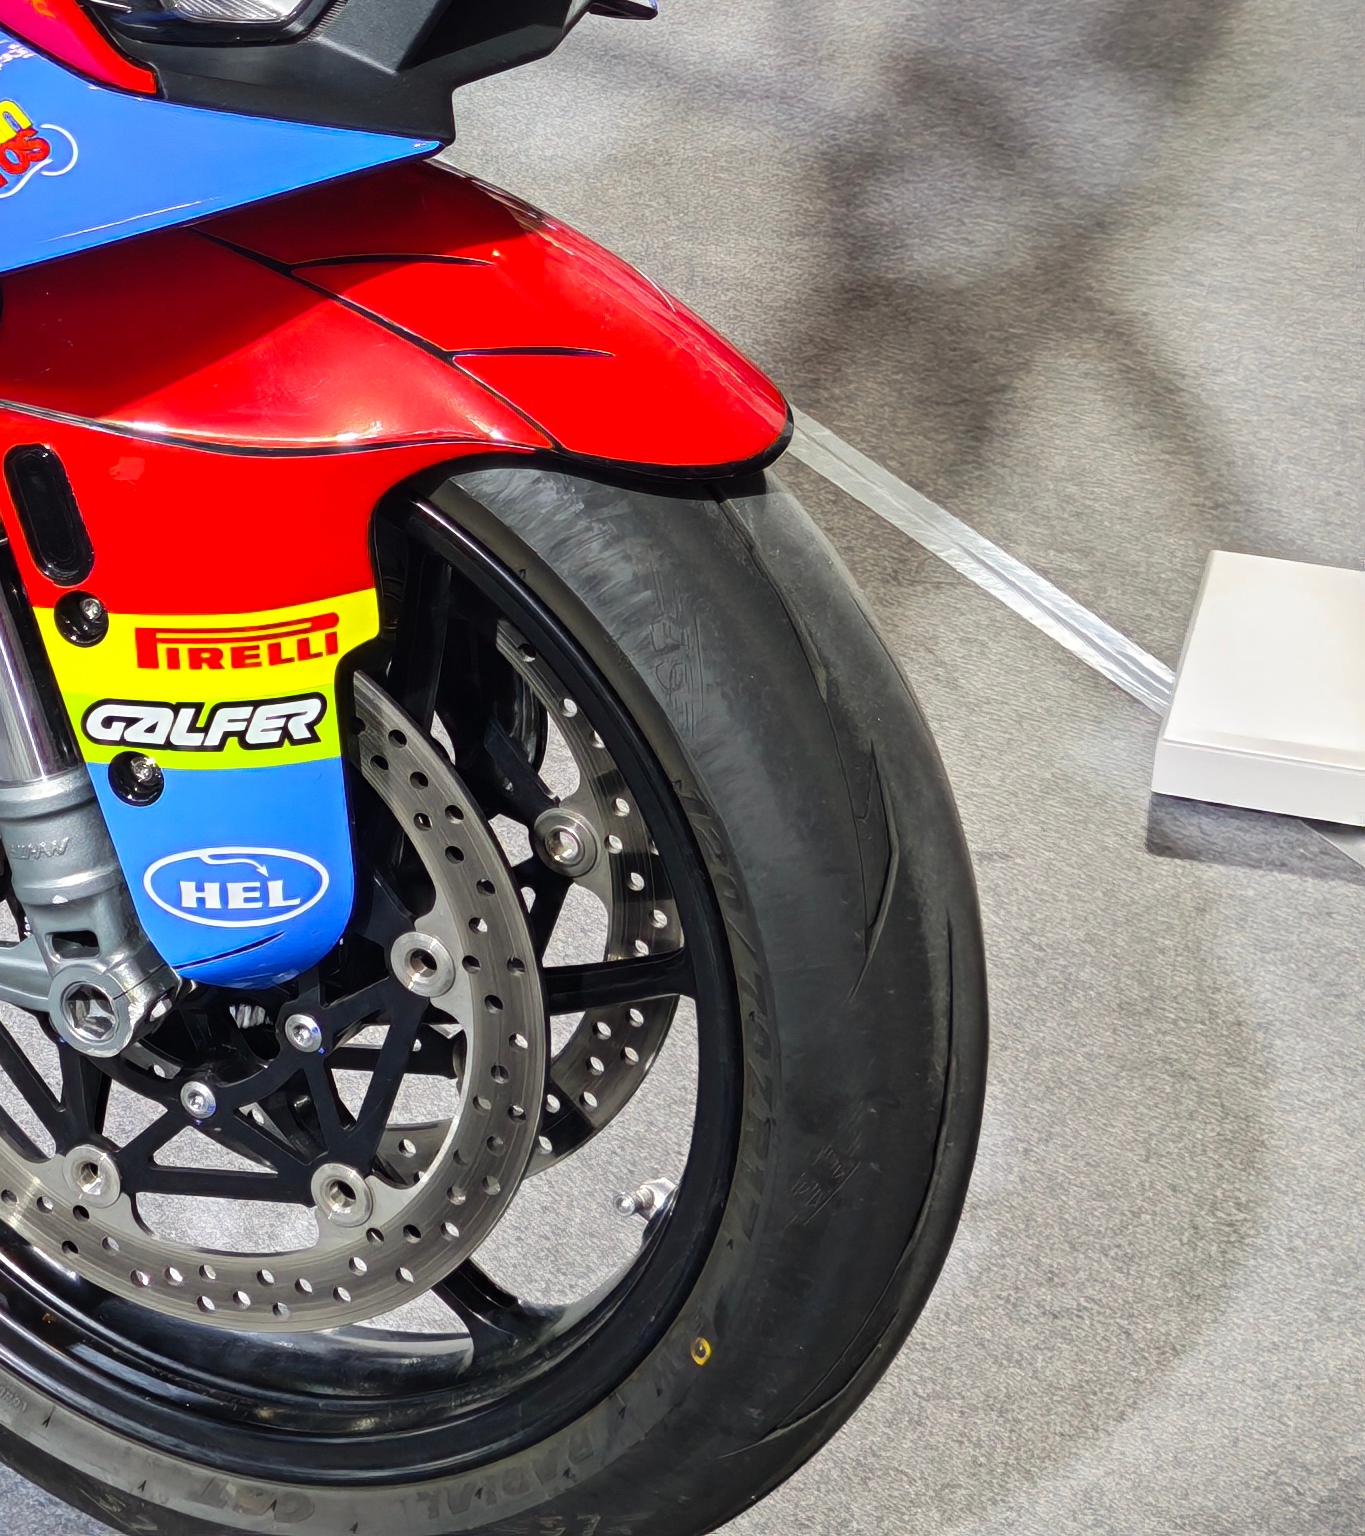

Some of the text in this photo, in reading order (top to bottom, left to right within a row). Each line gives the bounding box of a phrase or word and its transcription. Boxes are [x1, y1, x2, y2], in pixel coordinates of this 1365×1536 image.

[135, 611, 340, 671] PIRELLI
[84, 696, 323, 747] GALFER
[180, 879, 302, 909] HEL
